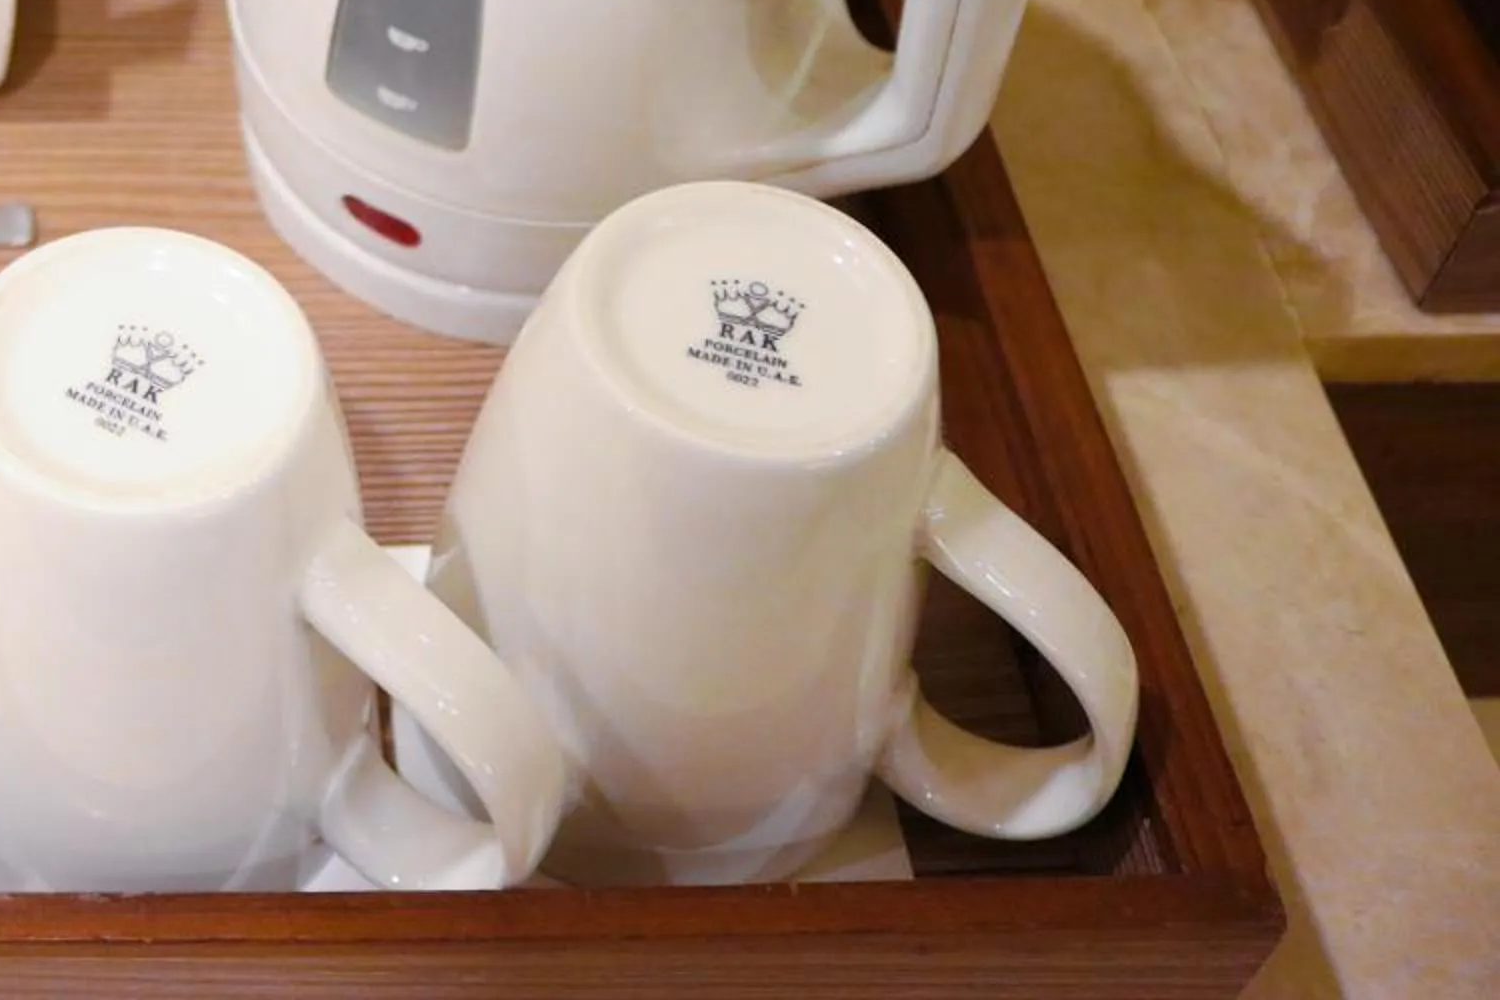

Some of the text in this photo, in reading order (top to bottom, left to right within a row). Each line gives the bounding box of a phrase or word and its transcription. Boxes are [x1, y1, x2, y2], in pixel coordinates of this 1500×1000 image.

[719, 322, 779, 352] RAK
[686, 346, 730, 367] MADE
[736, 359, 752, 373] IN
[704, 338, 788, 369] PORCELAIN
[86, 382, 162, 421] PORCELAIN
[106, 367, 162, 405] RAK
[65, 388, 105, 412] MADE
[109, 406, 124, 421] IN
